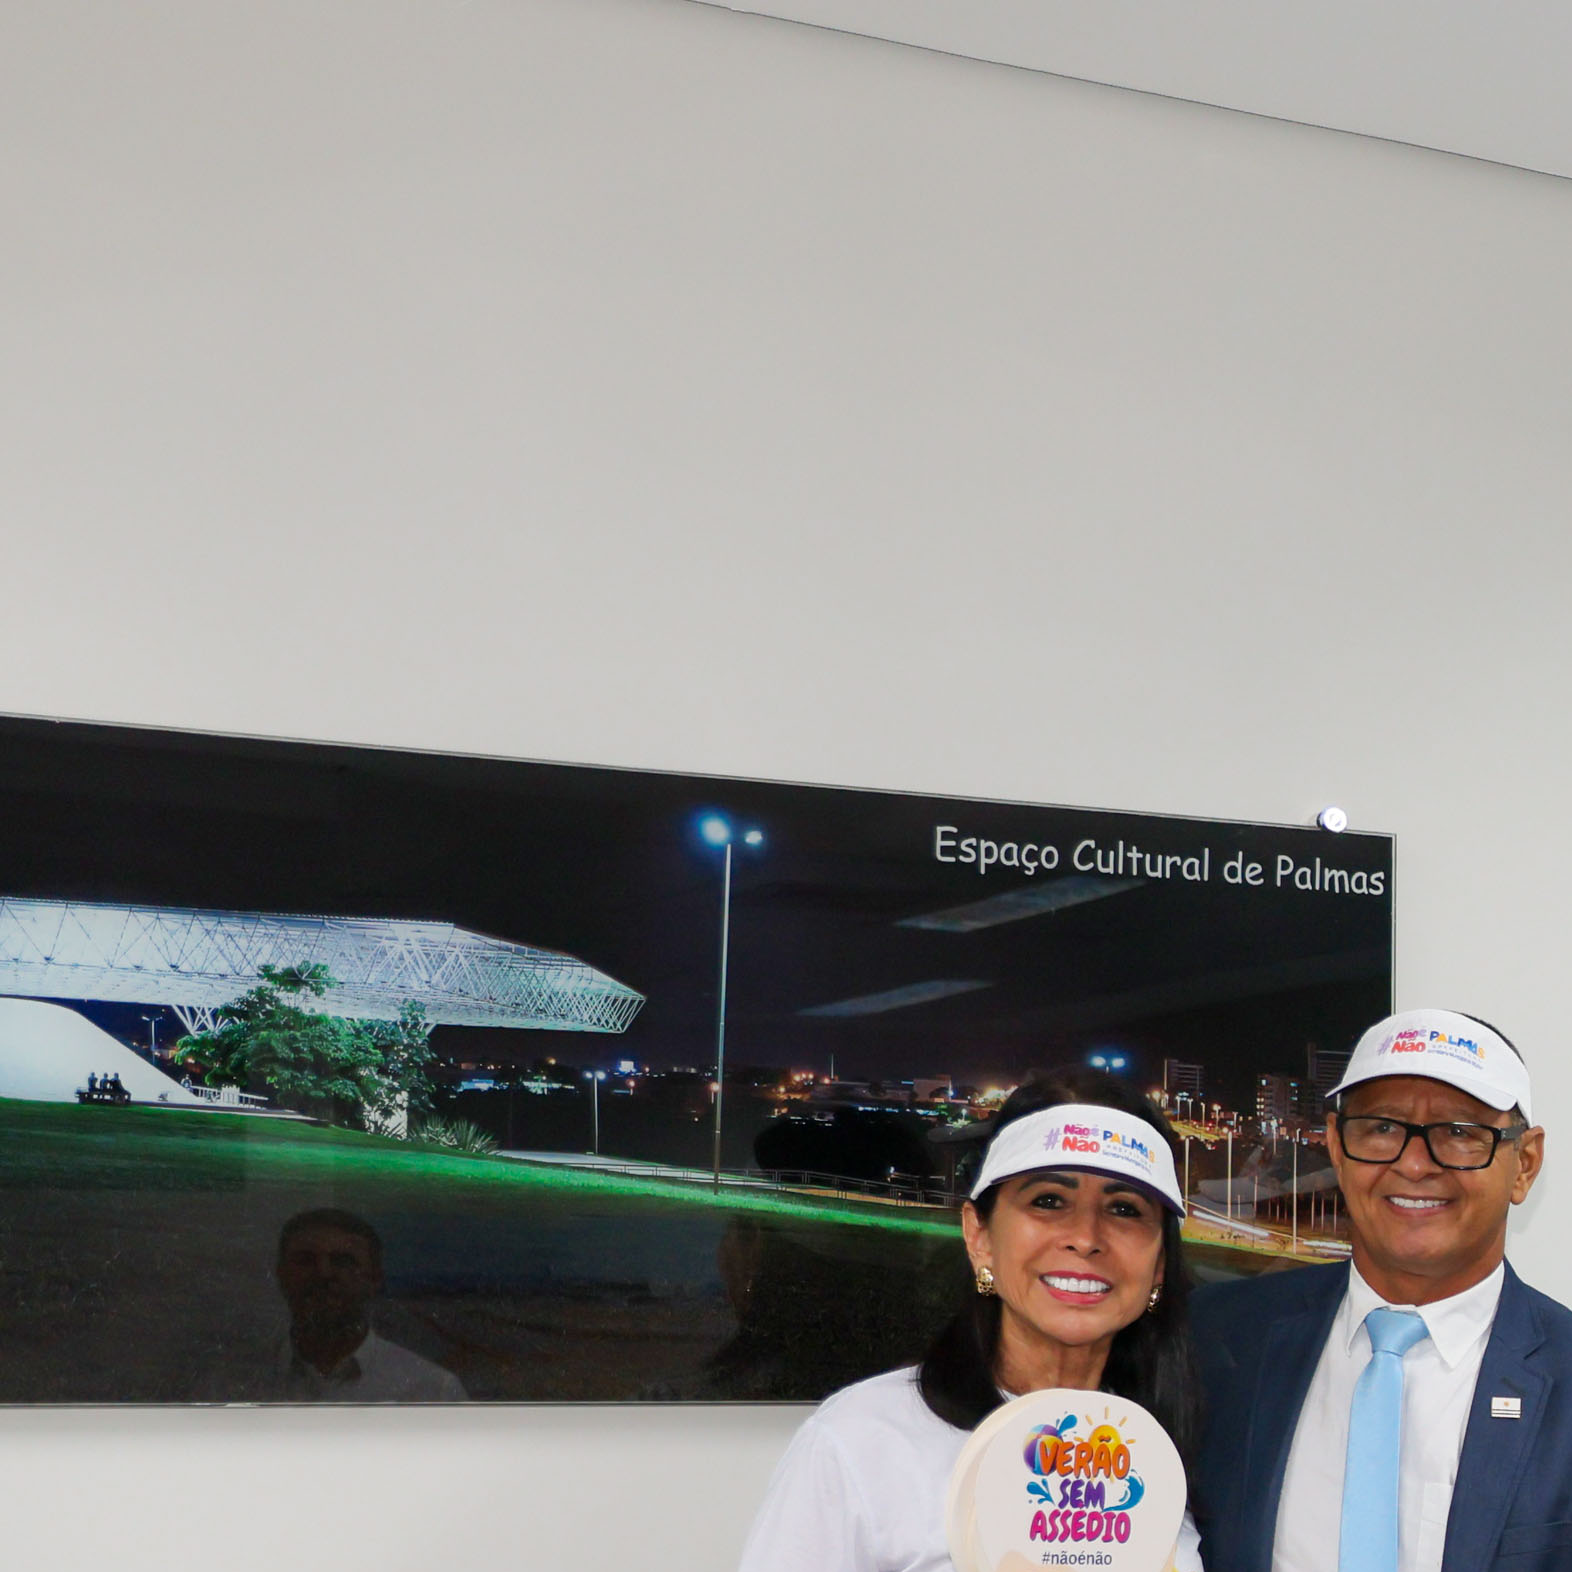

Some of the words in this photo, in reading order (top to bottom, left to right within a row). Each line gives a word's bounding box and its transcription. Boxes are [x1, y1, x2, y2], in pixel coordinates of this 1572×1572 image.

[935, 825, 1059, 875] Espaço
[1073, 839, 1209, 881] Cultural
[1223, 850, 1265, 886] de
[1276, 855, 1386, 896] Palmas
[1429, 1030, 1485, 1059] PALMAS
[1103, 1130, 1155, 1163] PALMAS
[1038, 1435, 1131, 1479] VERÃO
[1059, 1480, 1106, 1510] SEM
[1042, 1550, 1112, 1565] #nãoénão
